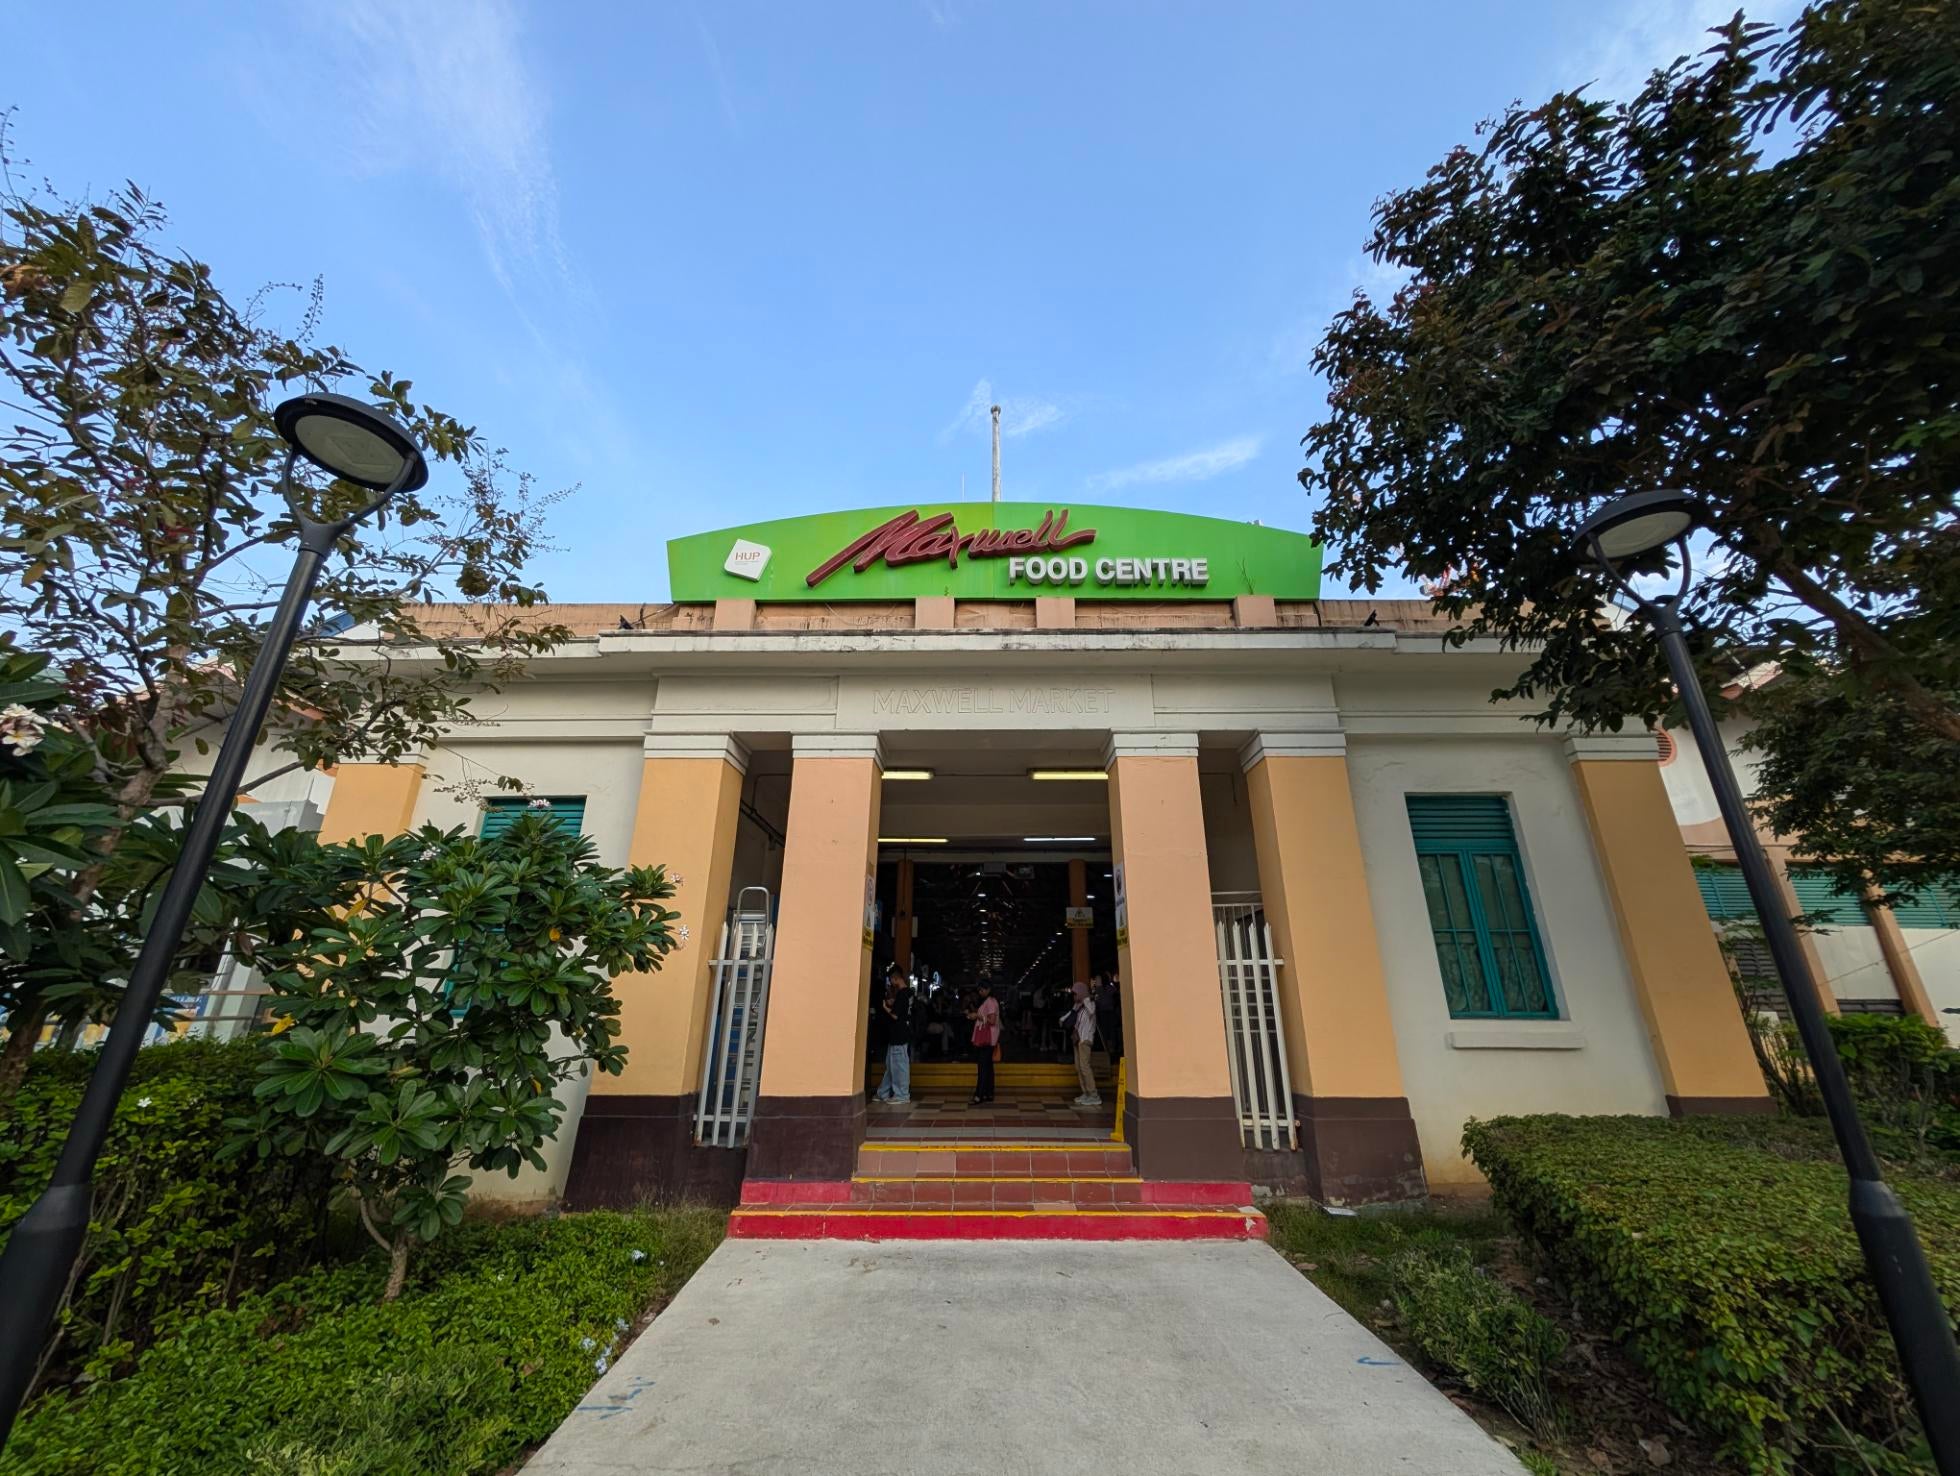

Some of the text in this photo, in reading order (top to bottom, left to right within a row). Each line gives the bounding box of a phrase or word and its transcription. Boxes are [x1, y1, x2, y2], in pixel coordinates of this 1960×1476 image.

[735, 552, 761, 561] HUP
[806, 509, 1096, 587] Maxwell
[1009, 556, 1209, 585] FOOD CENTRE
[872, 688, 1117, 714] MAXWELL MARKET
